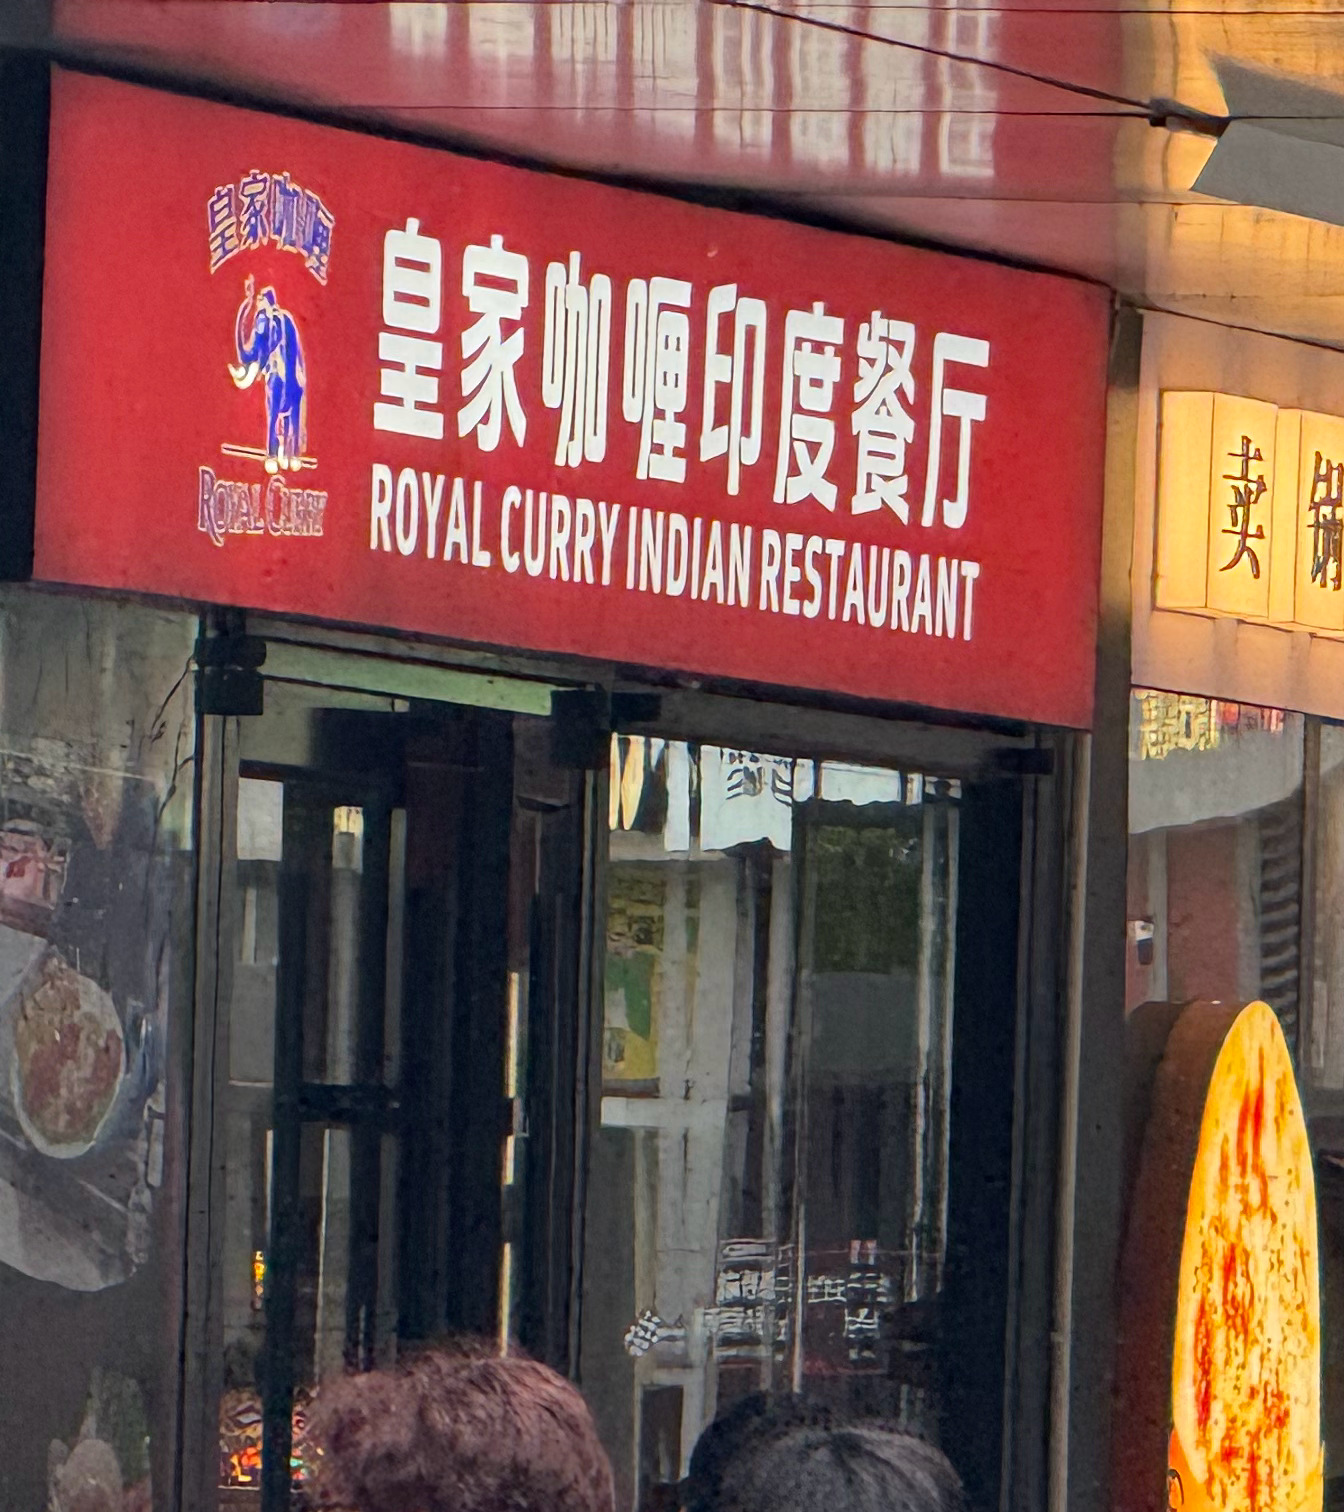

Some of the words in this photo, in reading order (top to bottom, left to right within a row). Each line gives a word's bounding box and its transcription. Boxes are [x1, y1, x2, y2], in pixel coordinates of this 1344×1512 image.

[373, 216, 990, 529] 皇家咖喱印度餐厅
[370, 463, 491, 568] ROYAL
[501, 485, 620, 586] CURRY
[627, 505, 752, 610] INDIAN
[759, 528, 980, 642] RESTAURANT
